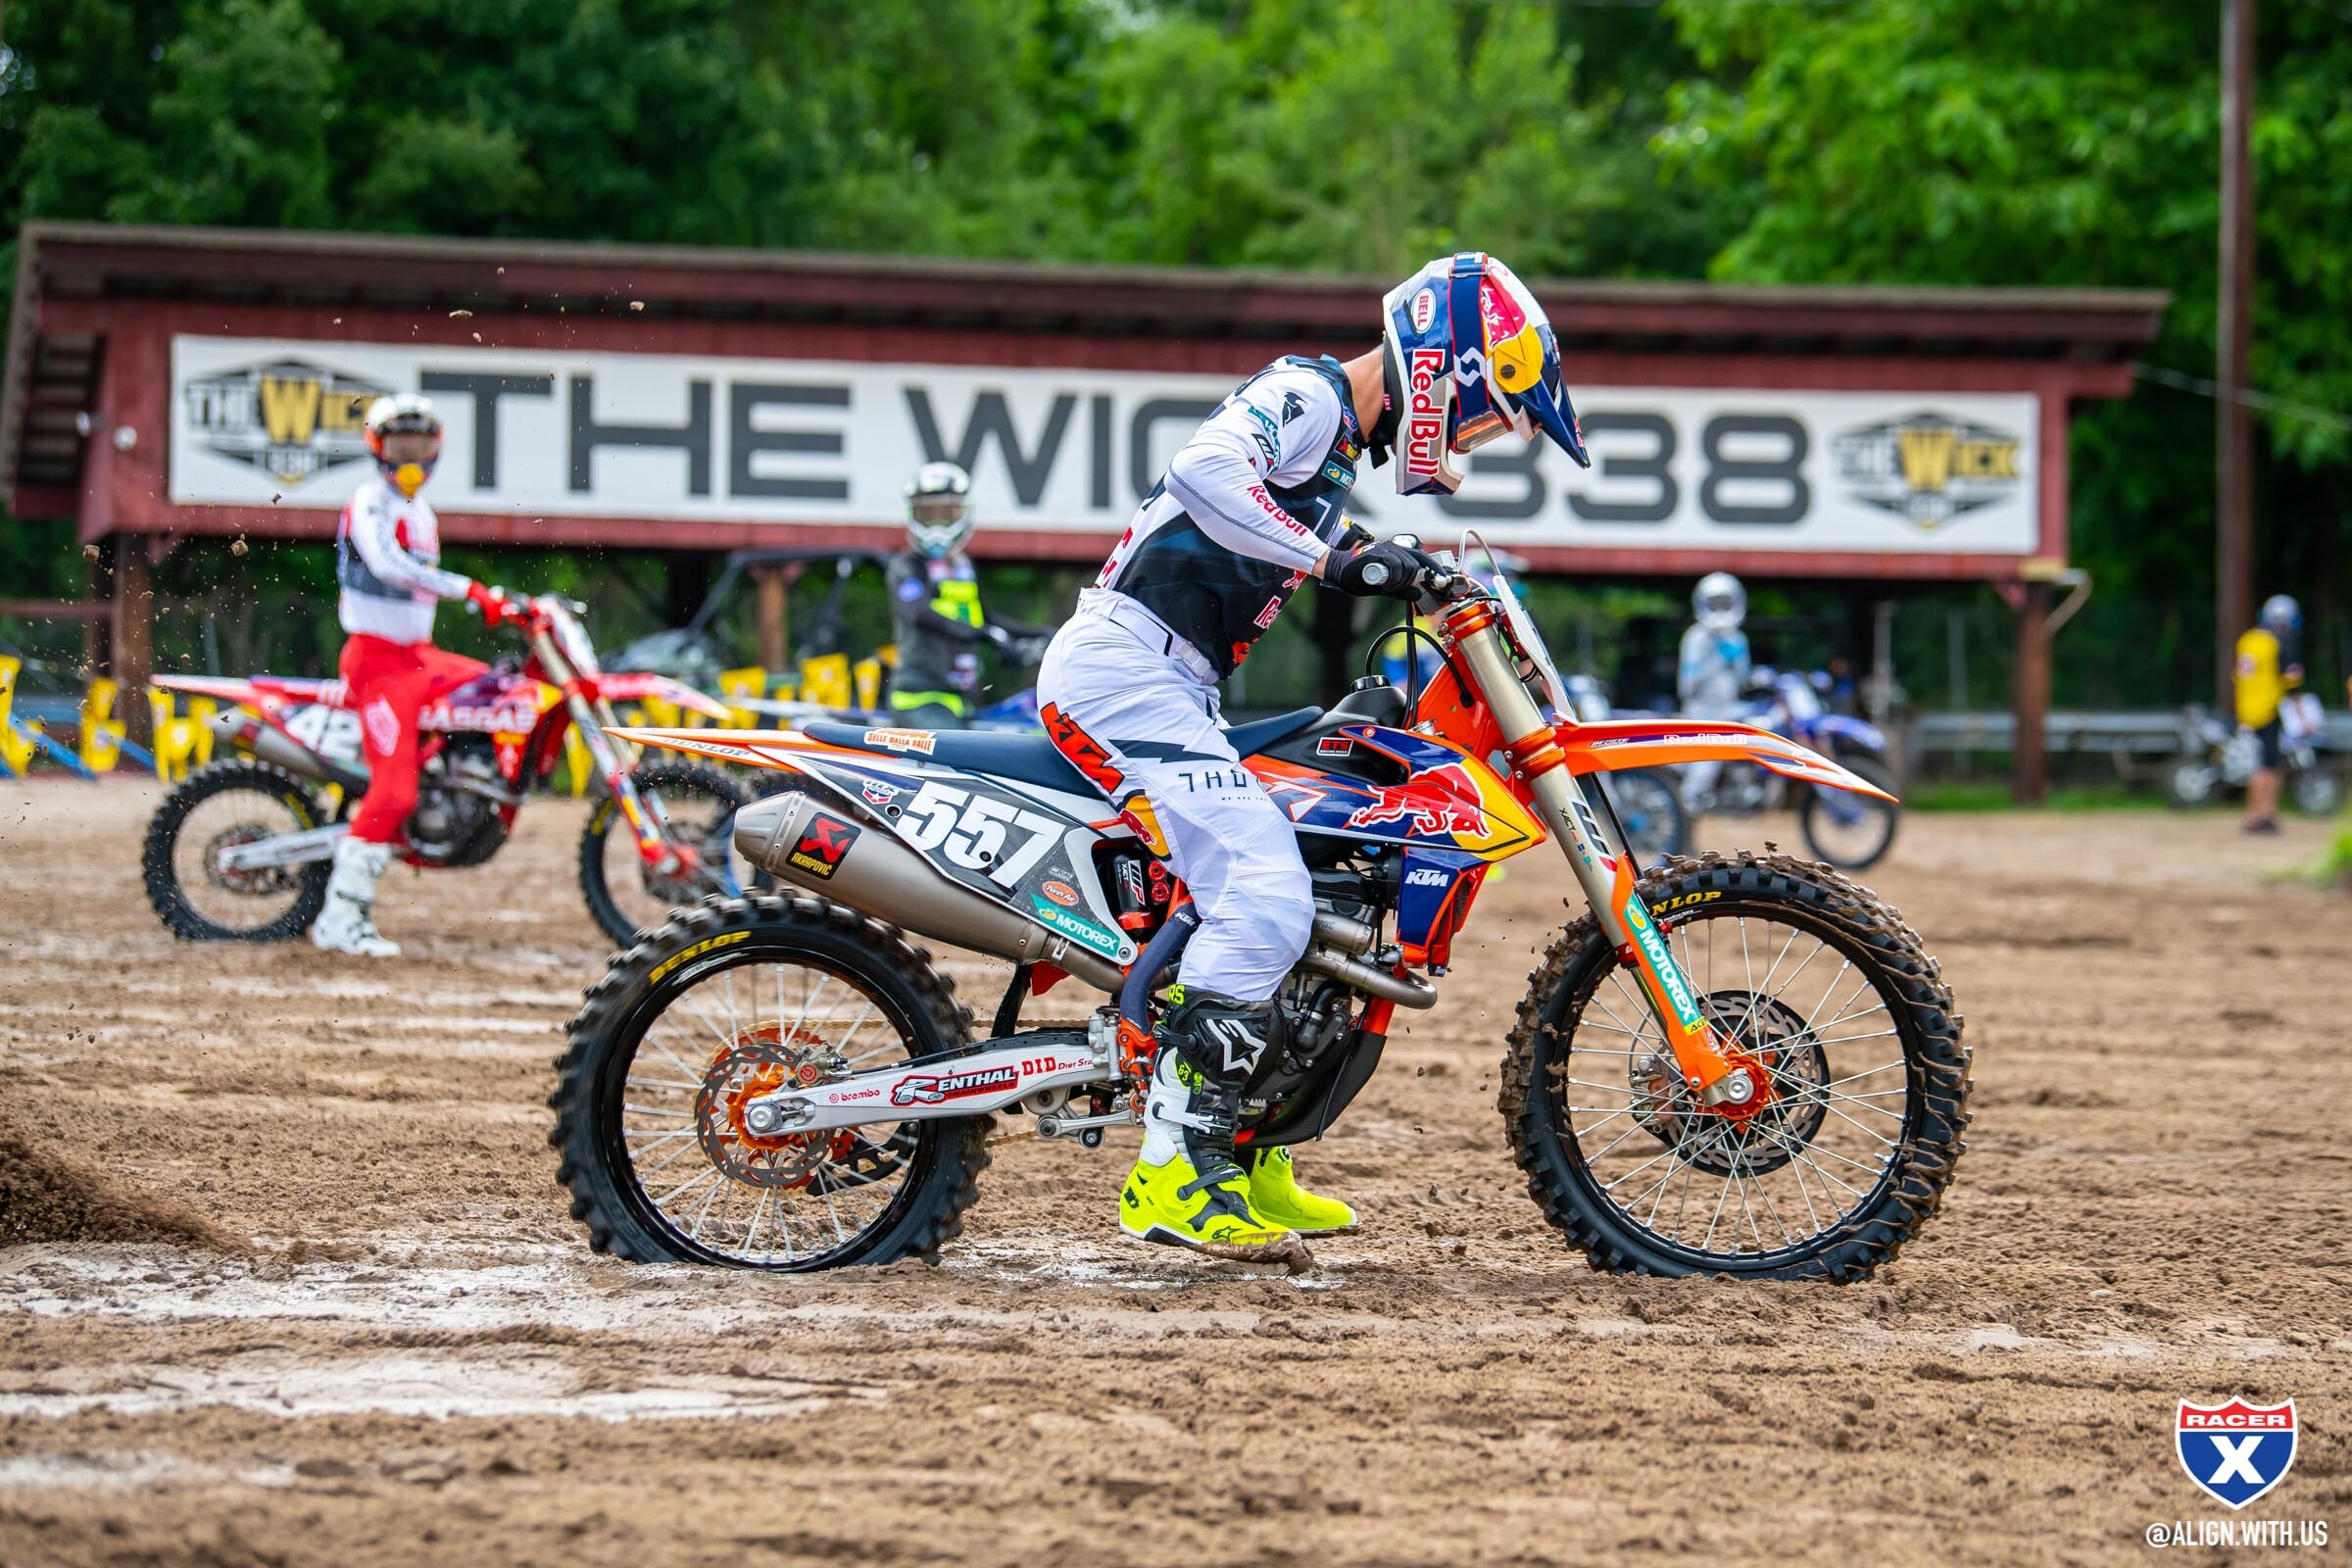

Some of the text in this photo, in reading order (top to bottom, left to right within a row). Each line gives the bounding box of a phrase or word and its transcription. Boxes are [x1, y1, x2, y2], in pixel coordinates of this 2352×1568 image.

[1416, 294, 1430, 327] BELL
[420, 370, 850, 500] THE
[1435, 412, 1809, 524] 338
[662, 736, 750, 758] DUNLOP
[867, 732, 888, 743] SELLE
[912, 739, 932, 751] VALLE
[1040, 701, 1125, 794] KTM
[1559, 808, 1576, 831] XACT
[896, 781, 1066, 889] 557
[1405, 868, 1448, 887] KTM
[1046, 885, 1064, 898] Twin
[1651, 891, 1722, 917] NLOP
[1175, 911, 1196, 927] KTM
[1055, 914, 1118, 951] MOTOREX
[1640, 928, 1696, 1021] MOTOREX
[1021, 1055, 1056, 1076] D.I.D
[841, 1088, 880, 1102] brembo
[893, 1067, 1016, 1104] RENTHAL
